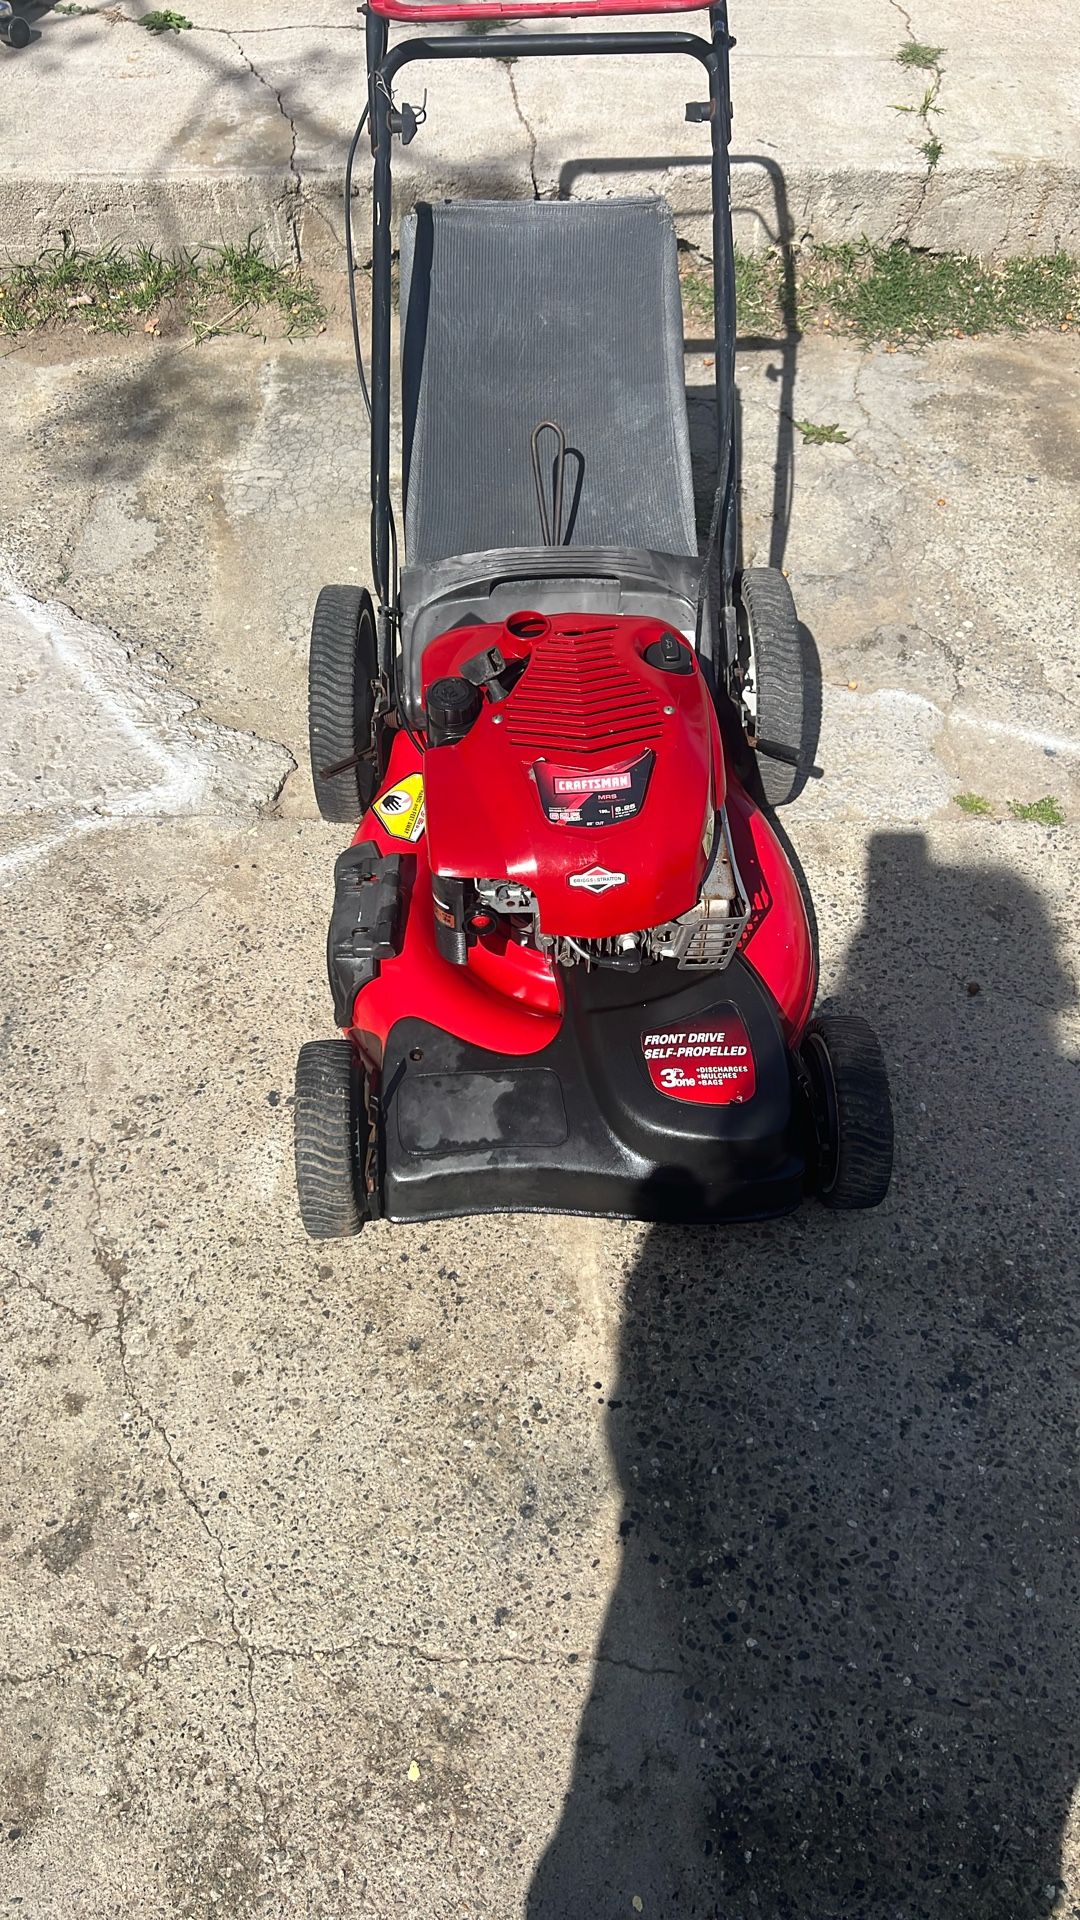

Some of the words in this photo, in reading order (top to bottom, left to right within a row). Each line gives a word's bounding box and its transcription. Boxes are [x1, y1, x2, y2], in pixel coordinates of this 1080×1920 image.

[559, 776, 628, 790] CRAFTSMAN
[408, 810, 416, 821] FEET
[404, 821, 412, 834] AWAY
[644, 1033, 686, 1045] FRONT
[688, 1032, 725, 1043] DRIVE
[644, 1045, 748, 1059] SELF-PROPELLED
